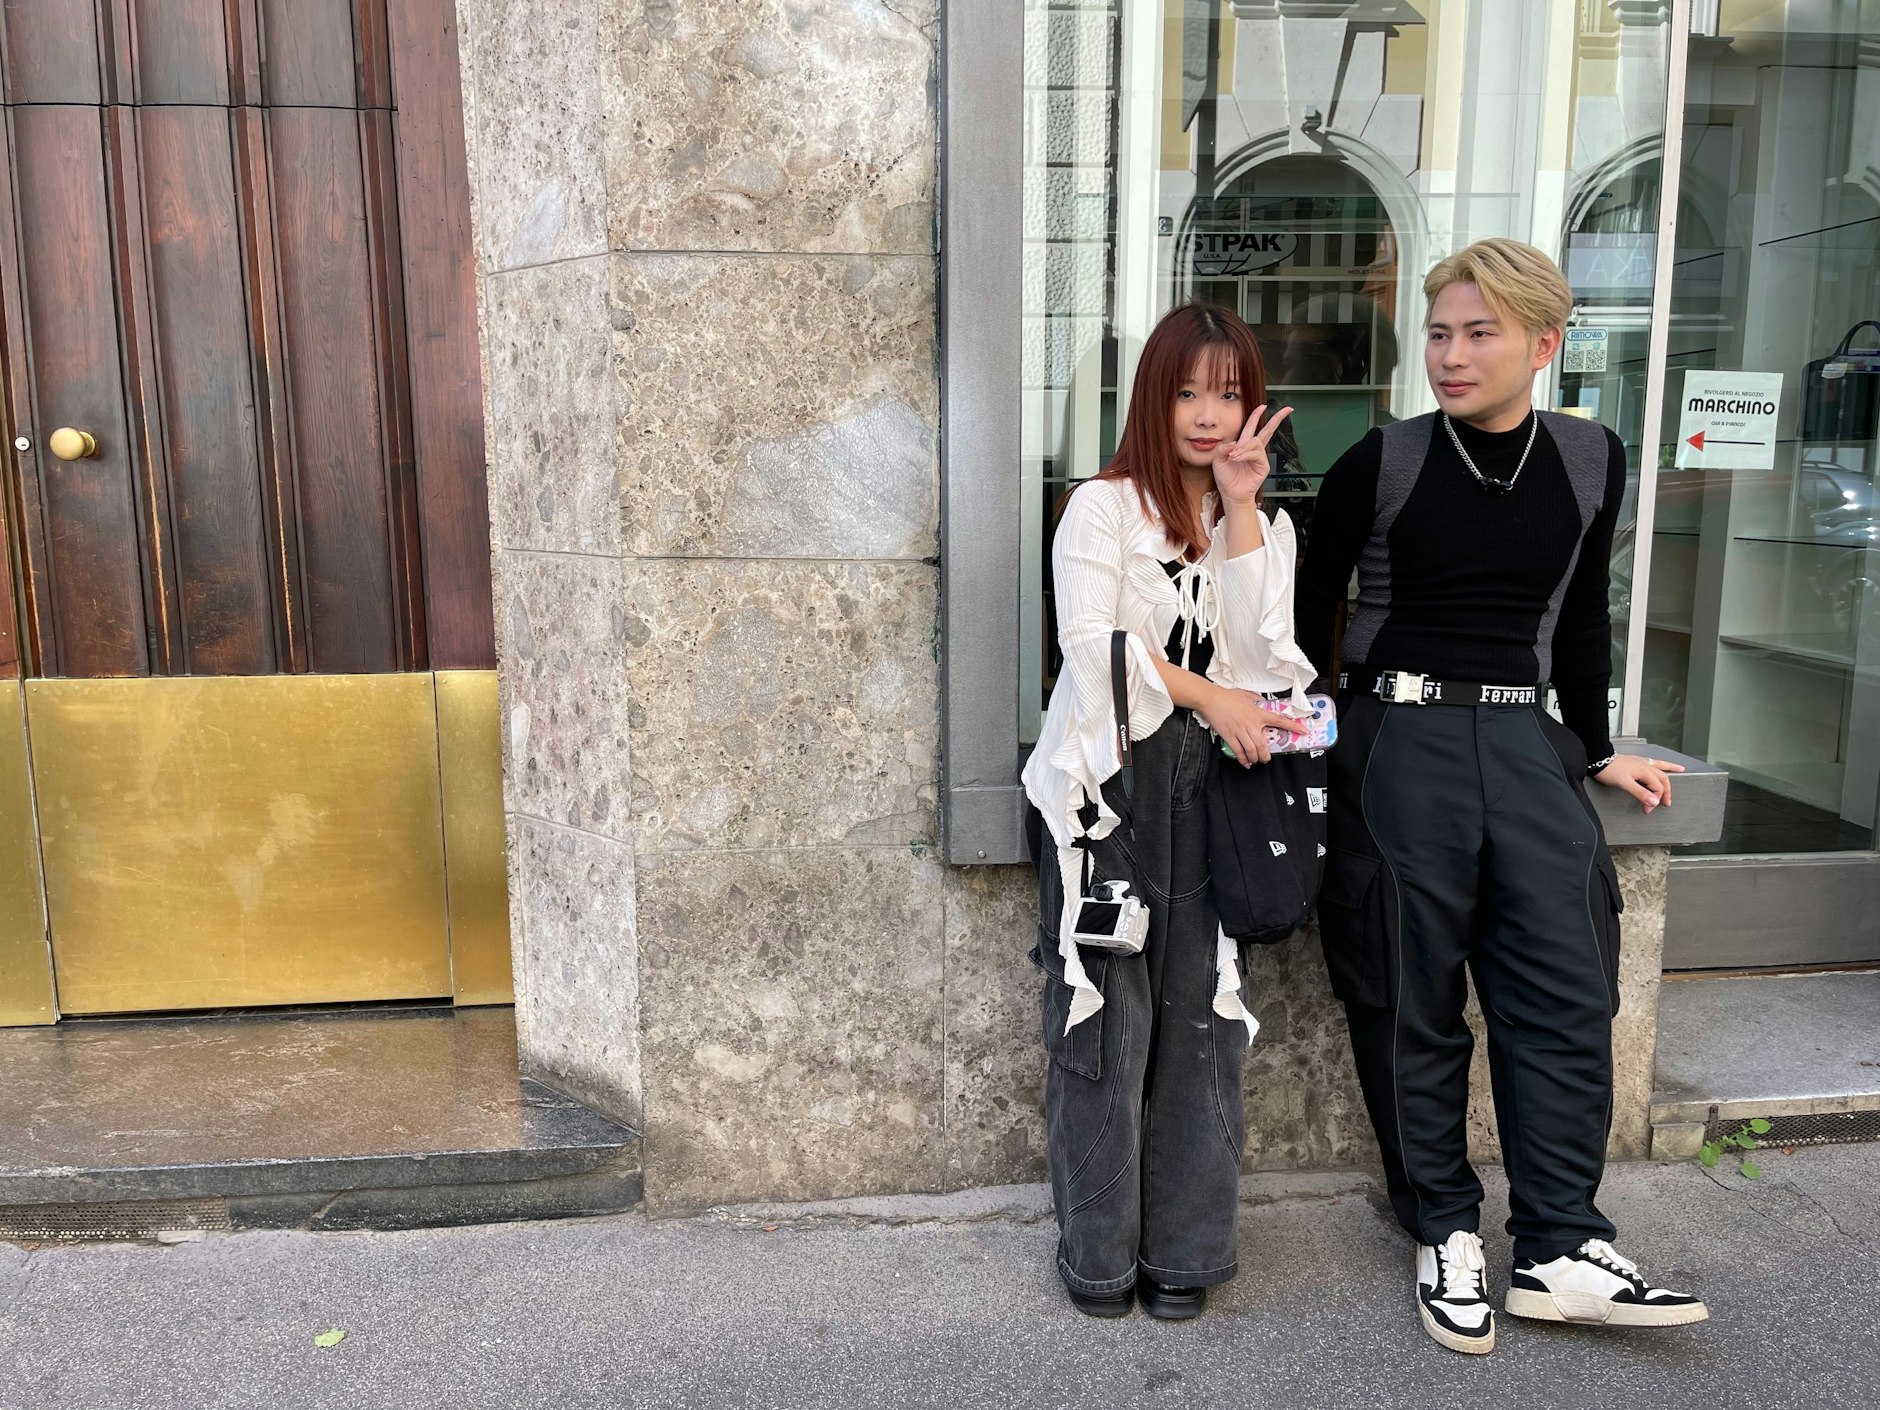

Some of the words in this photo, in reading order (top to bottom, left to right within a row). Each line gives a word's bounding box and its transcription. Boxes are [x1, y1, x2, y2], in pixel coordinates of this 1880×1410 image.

[1571, 331, 1603, 339] RIMOWA
[1688, 398, 1775, 415] MARCHINO
[1479, 685, 1536, 704] Ferrari
[1120, 724, 1128, 752] Canon
